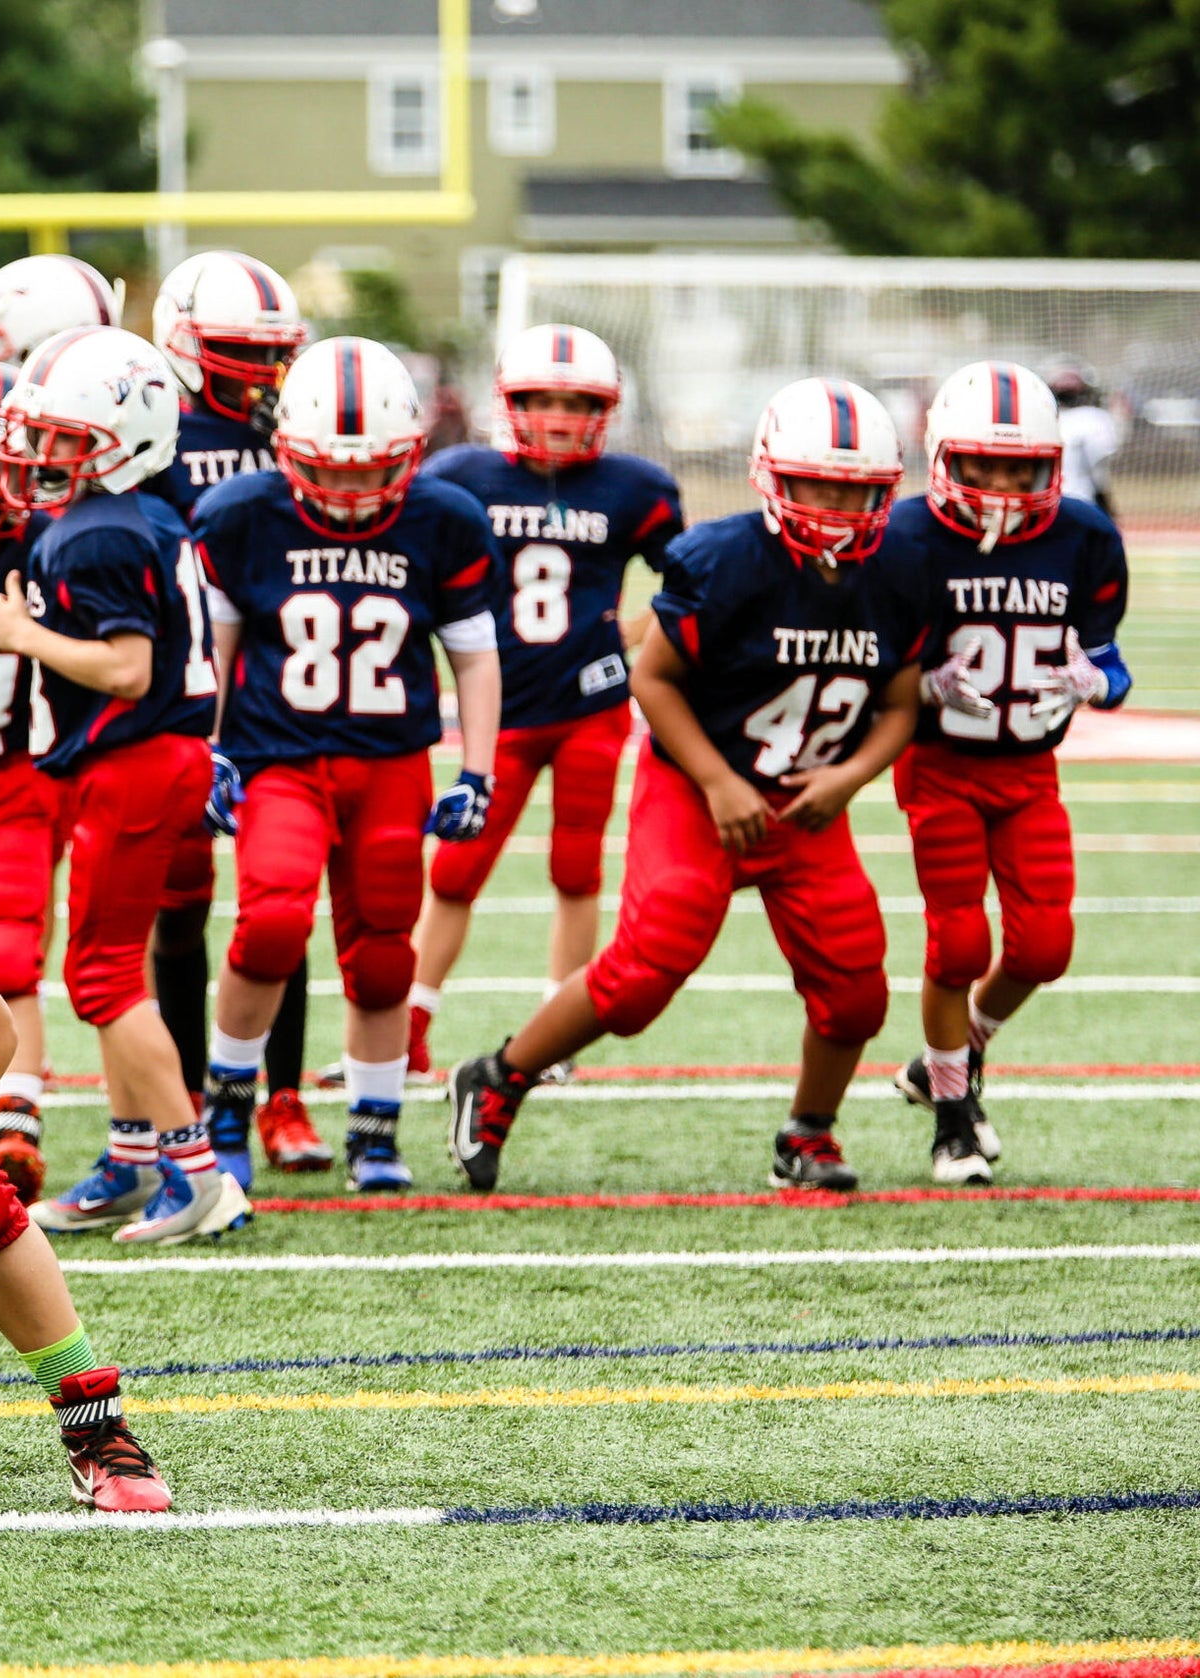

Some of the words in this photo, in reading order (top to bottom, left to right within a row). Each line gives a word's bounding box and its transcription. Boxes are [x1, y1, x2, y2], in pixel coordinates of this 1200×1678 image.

[487, 502, 609, 545] TITANS
[285, 547, 410, 590] TITANS
[511, 542, 572, 645] 8
[947, 576, 1070, 617] TITANS
[278, 590, 411, 716] 82
[773, 626, 881, 668] TITANS
[940, 623, 1064, 742] 25
[744, 673, 871, 778] 42
